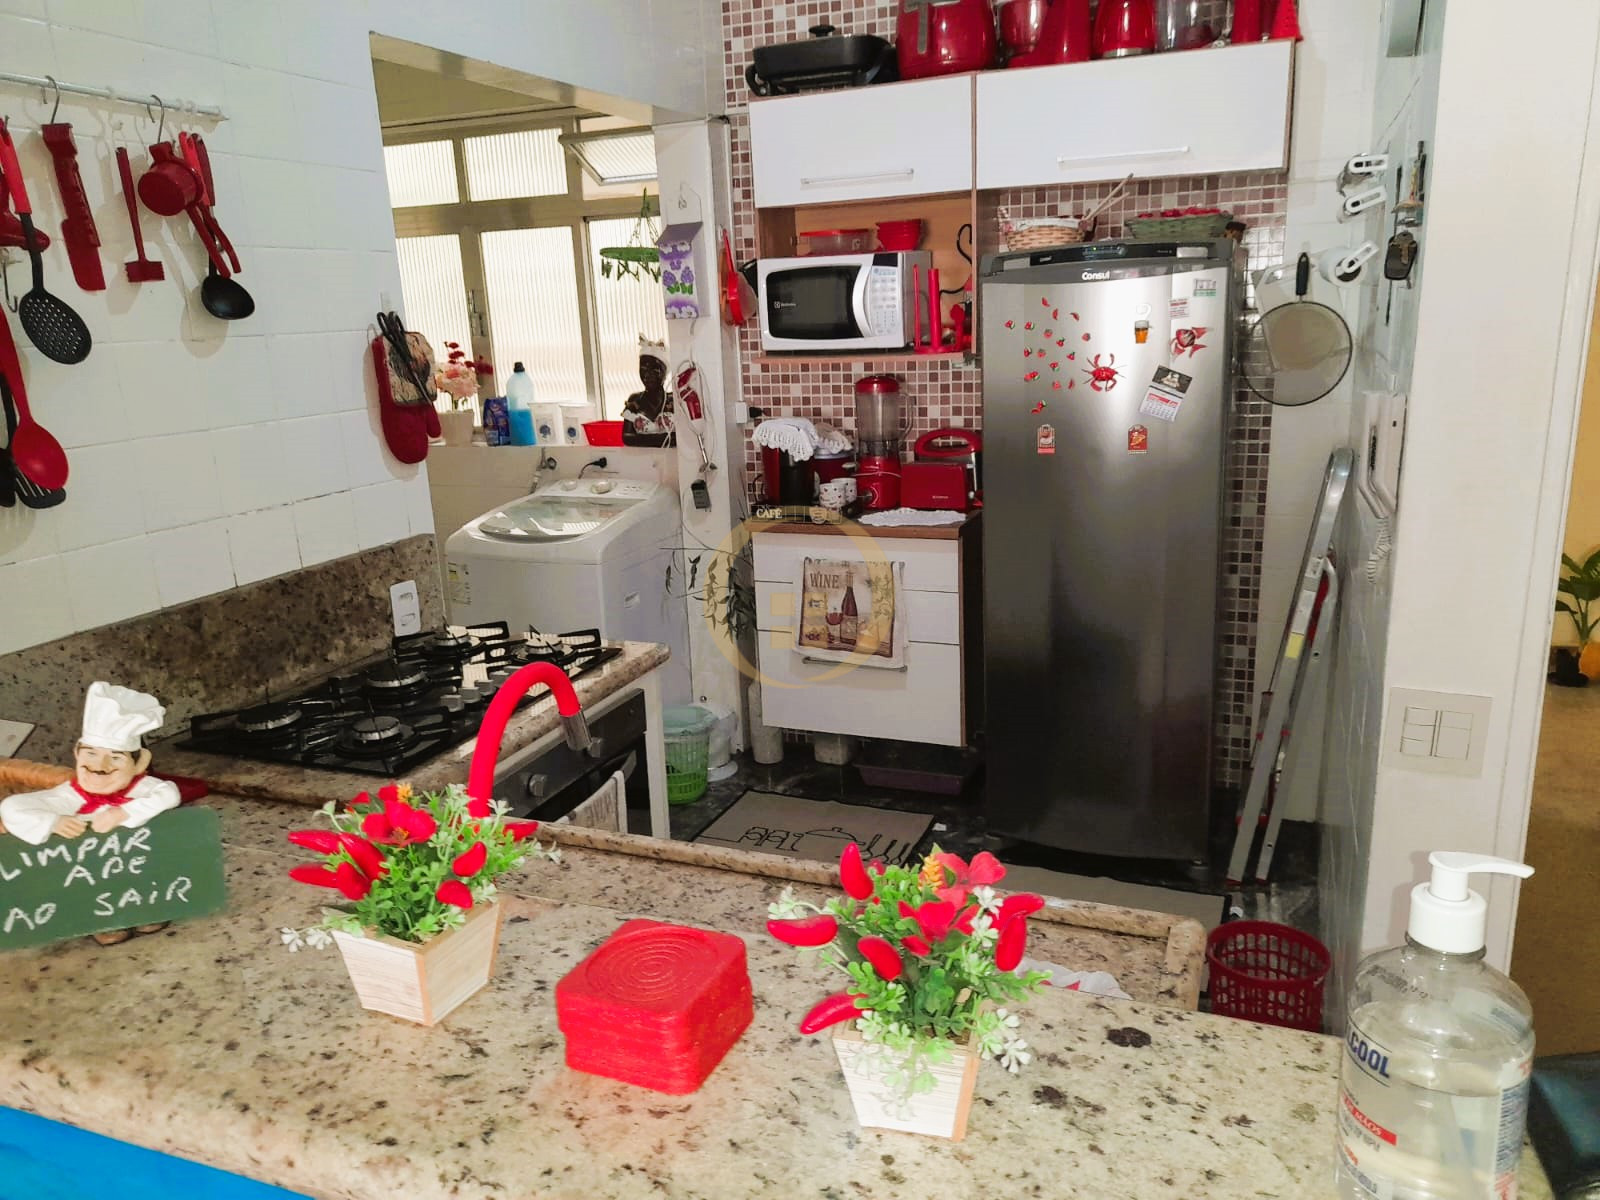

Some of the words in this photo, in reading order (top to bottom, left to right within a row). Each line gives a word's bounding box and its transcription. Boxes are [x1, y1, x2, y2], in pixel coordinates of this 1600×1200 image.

[1082, 270, 1110, 281] Consul
[809, 572, 840, 589] WINE
[0, 828, 151, 881] LIMPAR
[3, 902, 57, 933] AO
